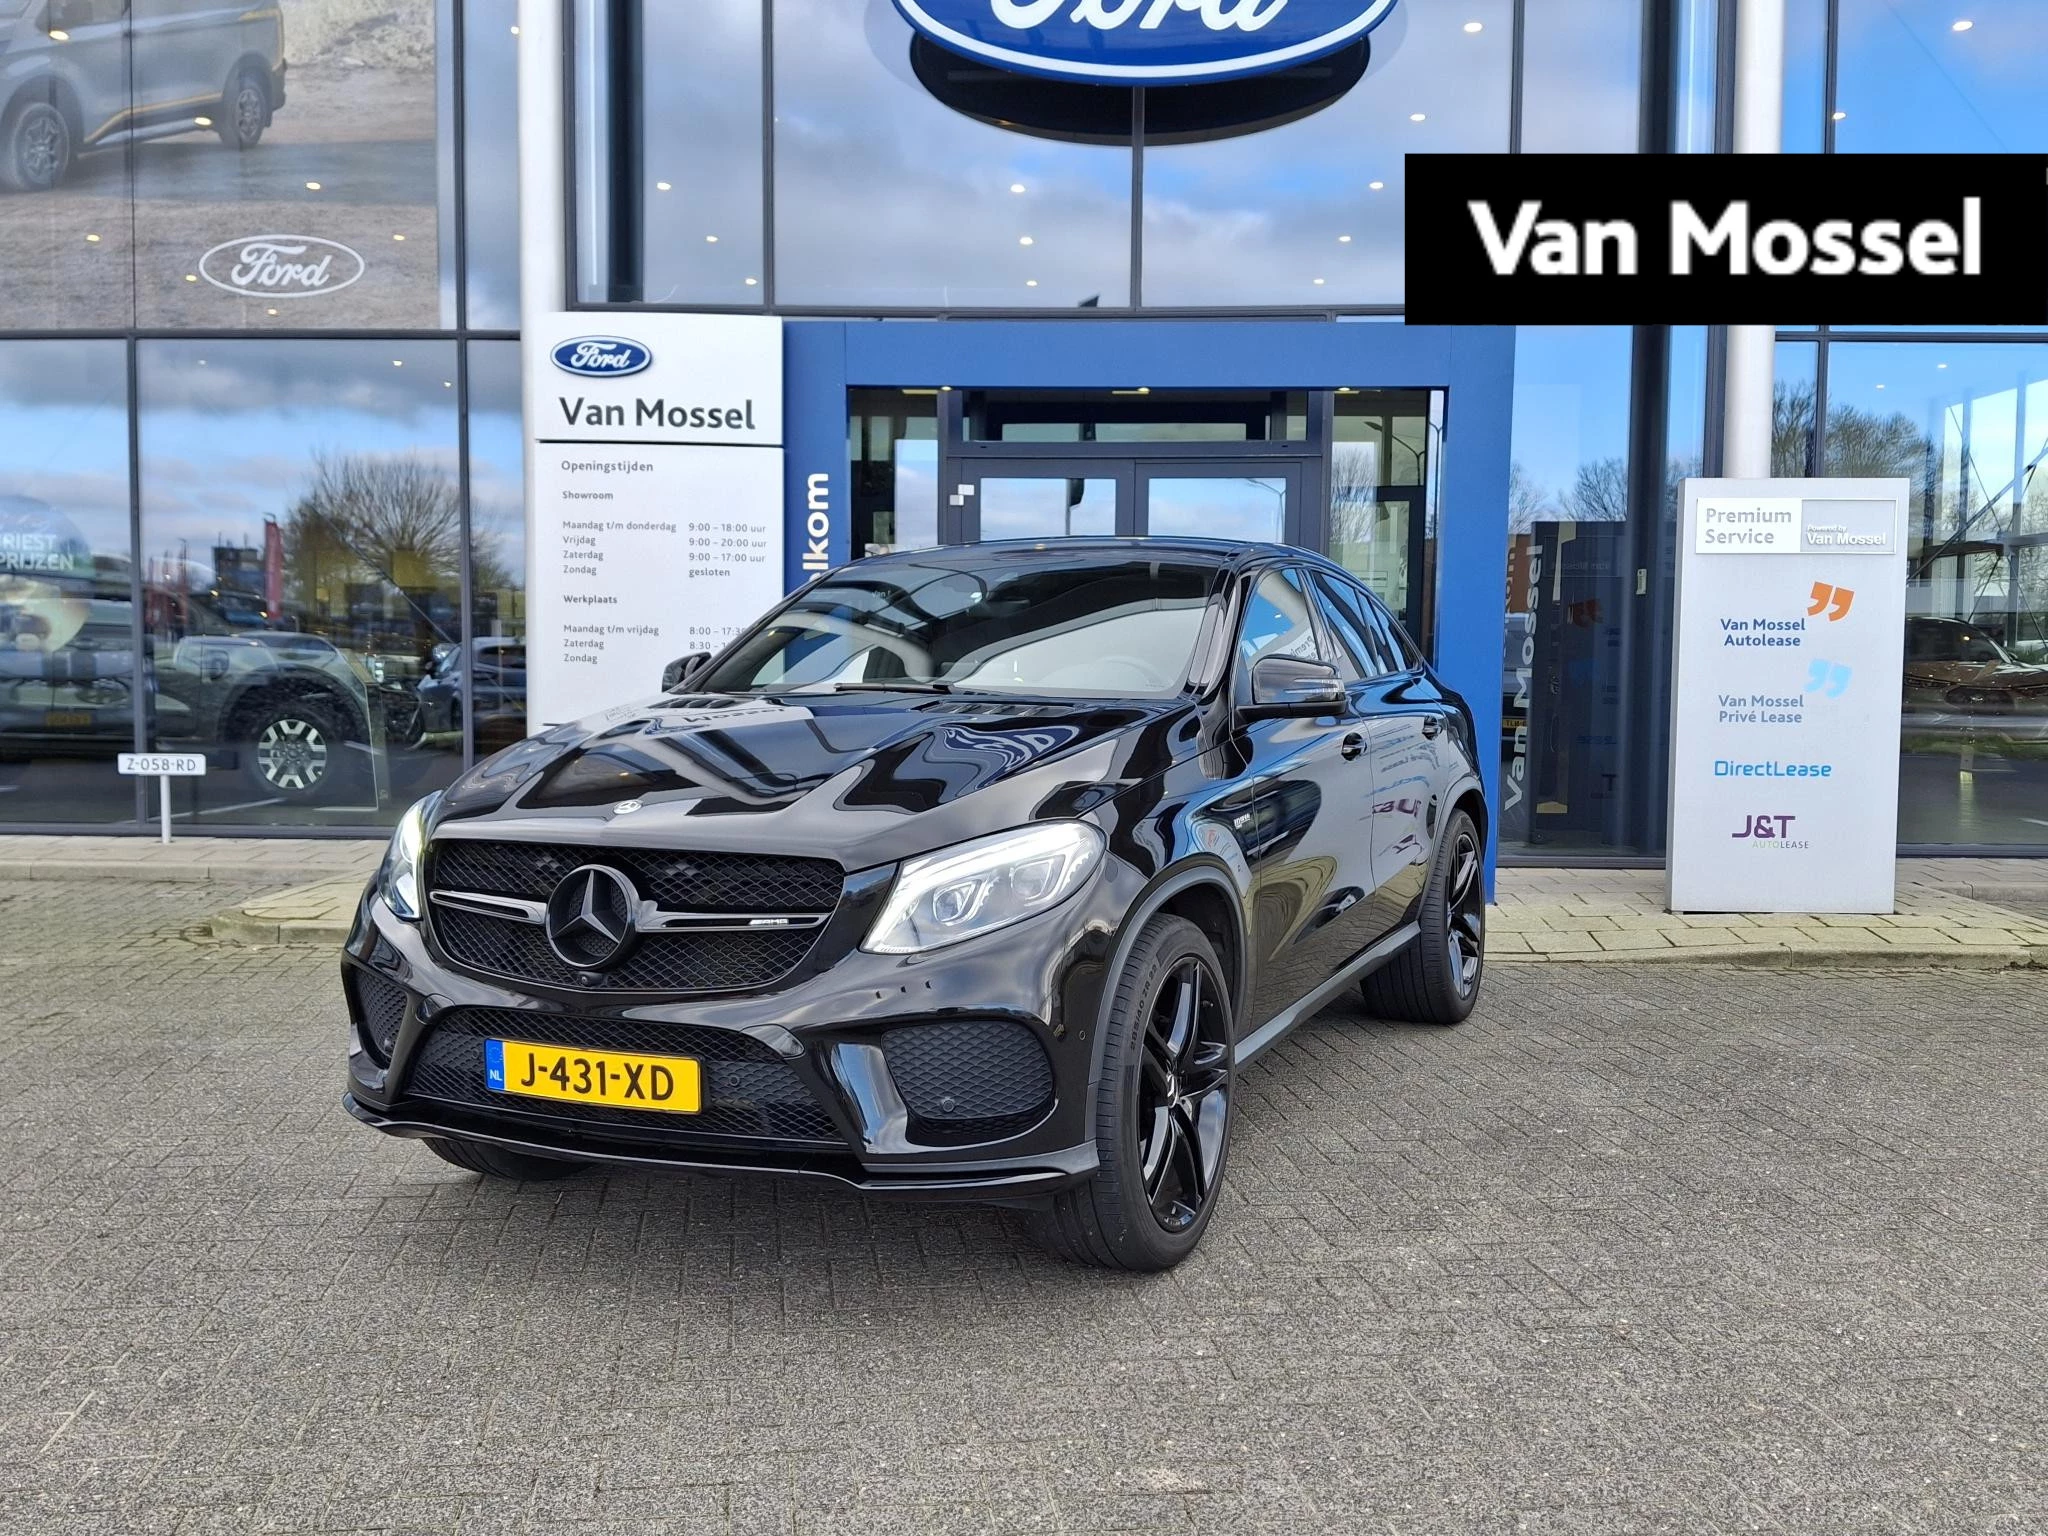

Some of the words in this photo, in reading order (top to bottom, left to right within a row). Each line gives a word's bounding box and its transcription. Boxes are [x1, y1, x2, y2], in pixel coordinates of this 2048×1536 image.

[231, 243, 333, 287] Ford
[570, 341, 632, 369] Ford
[559, 397, 625, 425] Van
[635, 398, 755, 430] Mossel
[561, 460, 654, 474] Openingstijden
[562, 491, 614, 500] Showroom
[1706, 507, 1792, 523] Premium
[562, 521, 604, 532] Maandag
[606, 521, 624, 530] t/m
[626, 521, 677, 533] donderdag
[688, 523, 711, 532] 9:00
[721, 523, 748, 533] 18:00
[750, 525, 767, 534] uur
[802, 473, 829, 582] lkom
[0, 533, 57, 550] RIEST
[562, 536, 596, 547] Vrijdag
[689, 538, 711, 547] 9:00
[720, 538, 749, 548] 20:00
[751, 540, 767, 548] uur
[1705, 528, 1775, 544] Service
[1807, 532, 1833, 545] Van
[1836, 532, 1887, 545] Mossel
[563, 550, 604, 561] Zaterdag
[689, 552, 711, 562] 9:00
[721, 553, 747, 563] 17:00
[749, 555, 766, 563] uur
[563, 565, 597, 576] Zondag
[689, 567, 731, 577] gesloten
[563, 595, 618, 606] Werkplaats
[563, 624, 605, 636] Maandag
[607, 625, 625, 634] t/m
[627, 625, 659, 636] vrijdag
[689, 626, 711, 636] 8:00
[1513, 545, 1543, 708] Mossel
[1720, 618, 1748, 631] Van
[1752, 617, 1805, 631] Mossel
[563, 639, 605, 650] Zaterdag
[689, 641, 711, 650] 8:30
[1723, 634, 1801, 647] Autolease
[563, 654, 598, 665] Zondag
[1718, 695, 1747, 708] Van
[1751, 694, 1804, 708] Mossel
[1719, 710, 1757, 723] Privé
[1761, 710, 1803, 723] Lease
[127, 757, 196, 772] Z-058-RD
[1504, 726, 1528, 811] Van
[1714, 760, 1832, 777] DirectLease
[1731, 814, 1796, 838] J&T
[1752, 840, 1810, 849] AUTOLEASE
[489, 1069, 503, 1082] NL
[521, 1052, 674, 1101] J-431-XD
